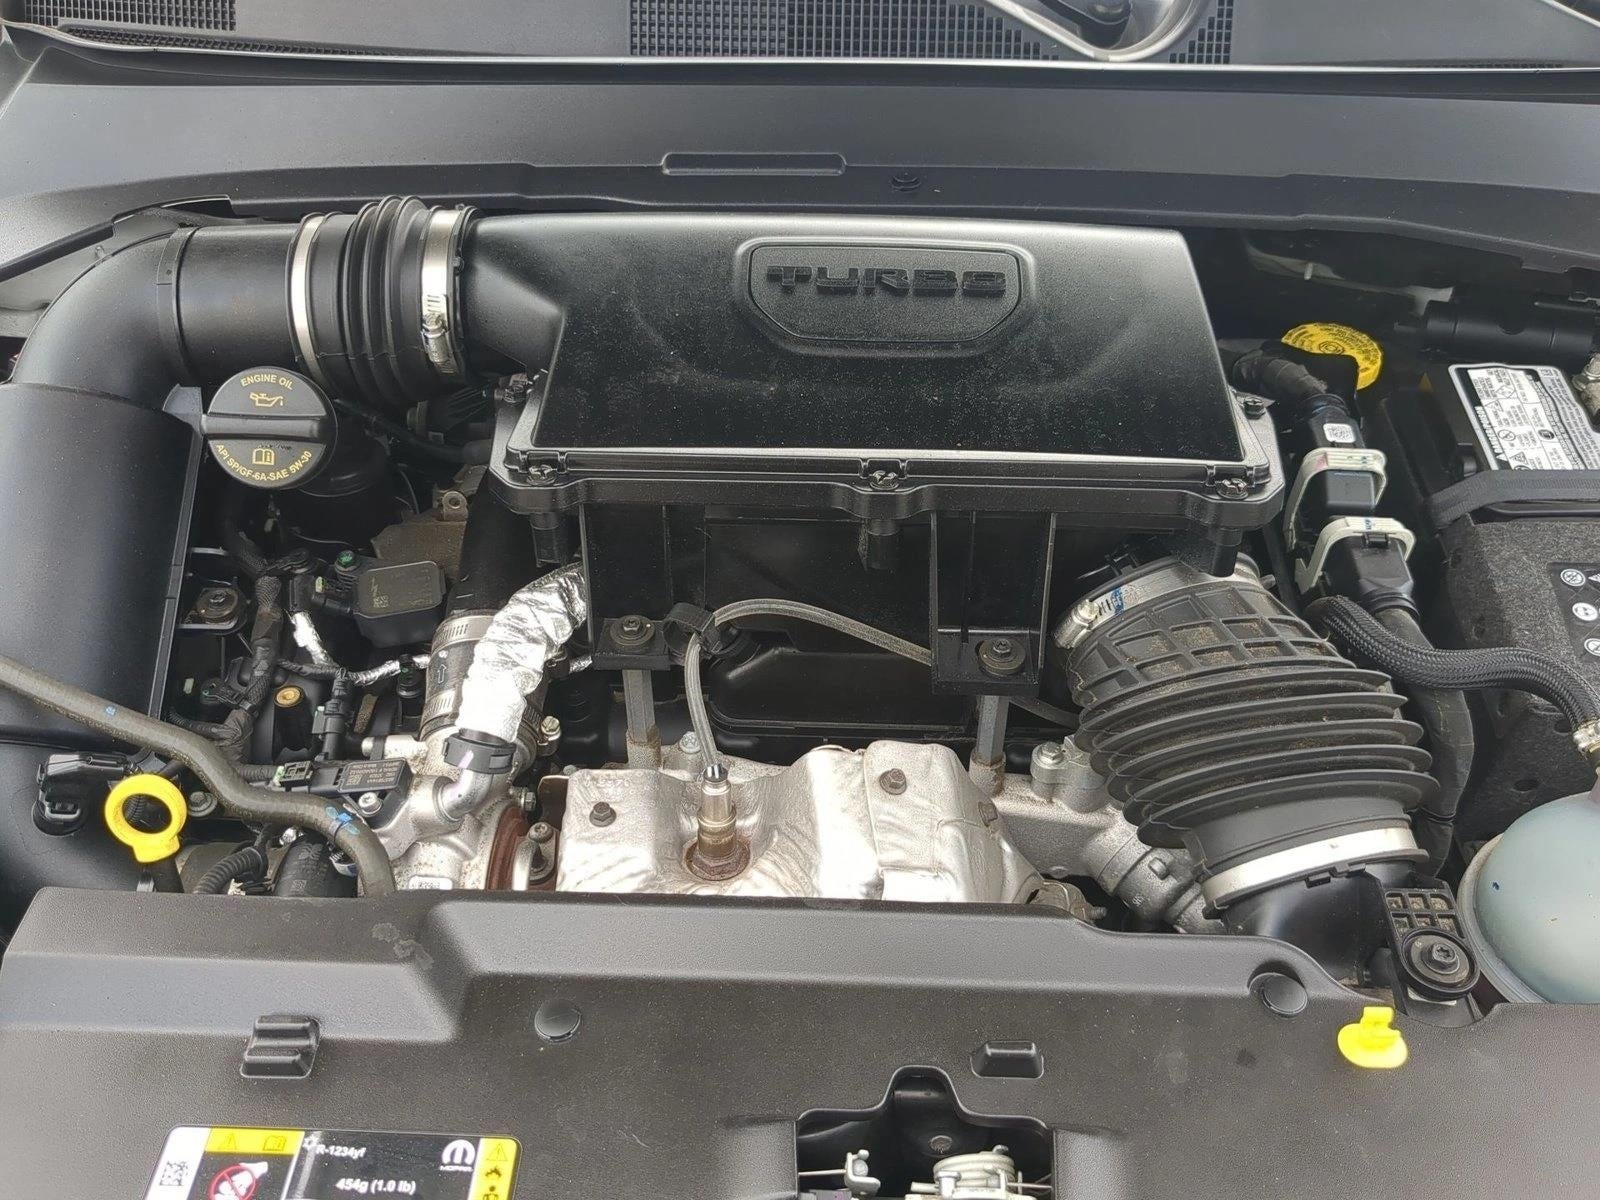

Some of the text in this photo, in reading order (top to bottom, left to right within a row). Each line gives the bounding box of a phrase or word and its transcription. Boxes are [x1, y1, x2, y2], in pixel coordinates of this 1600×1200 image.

[766, 266, 1006, 297] TURBO
[241, 374, 294, 390] ENGINE OIL
[289, 450, 312, 473] 5W-30
[316, 1144, 367, 1160] R-1234yf
[335, 1178, 416, 1195] 454g (1.0 lb)
